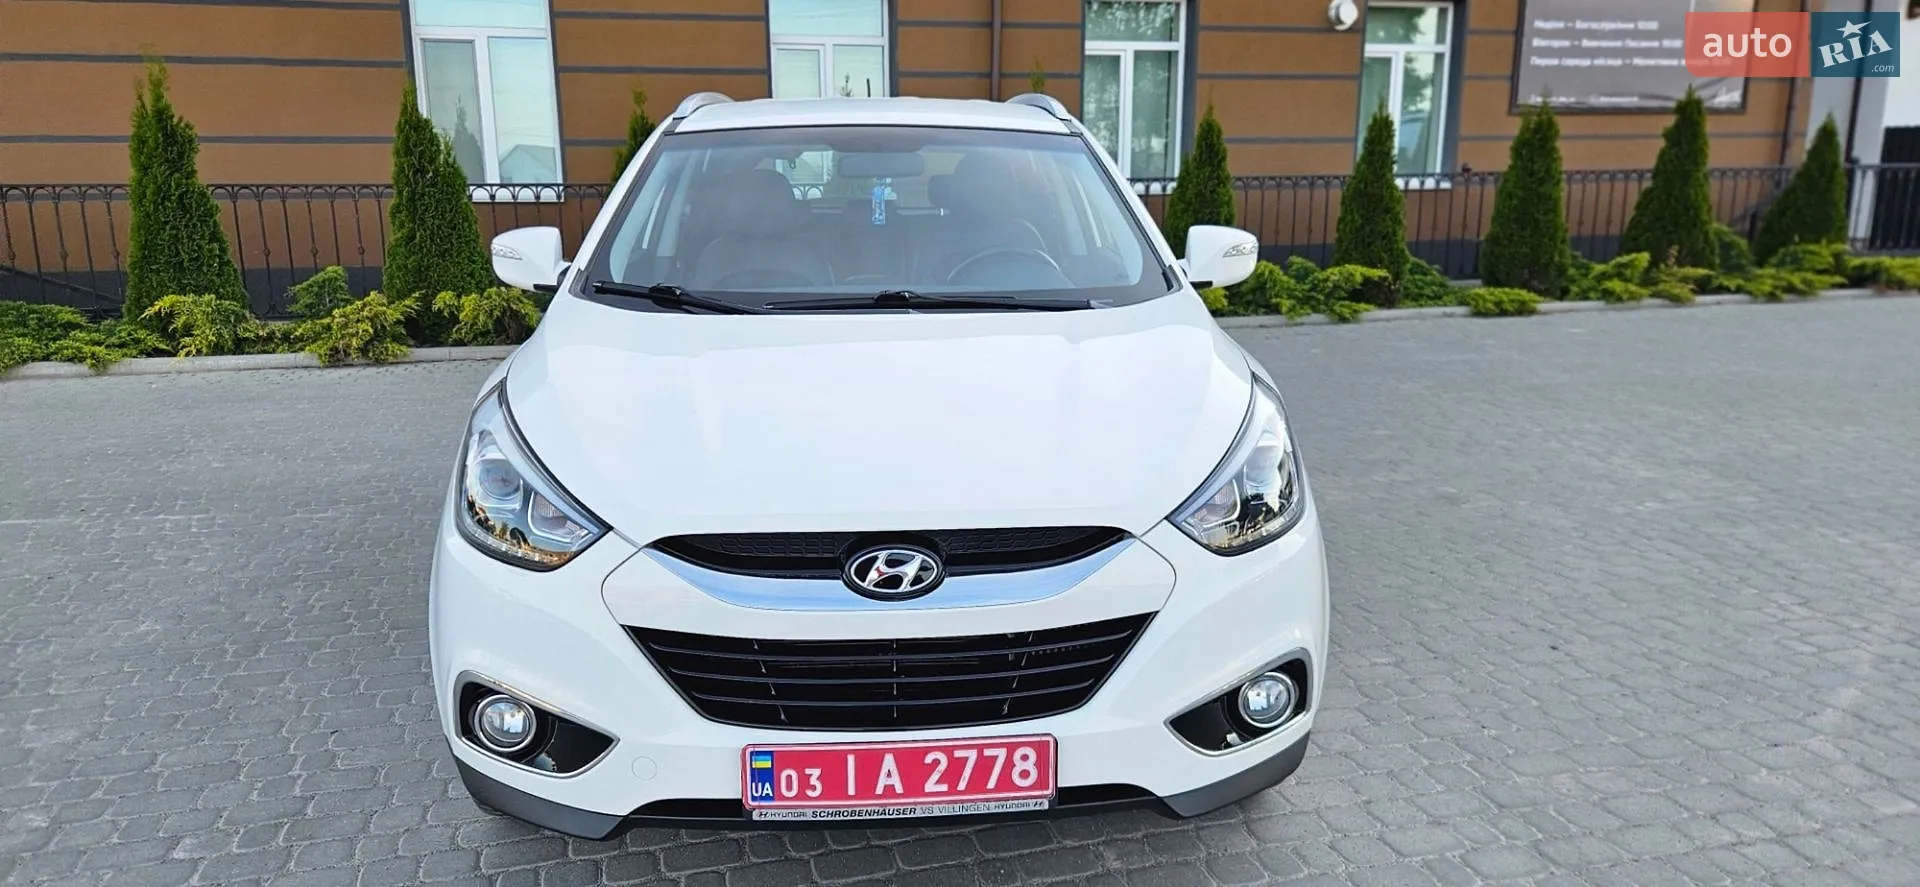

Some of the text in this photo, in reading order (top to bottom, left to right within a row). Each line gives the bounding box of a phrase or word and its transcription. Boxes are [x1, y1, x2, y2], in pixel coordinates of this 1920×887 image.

[780, 768, 822, 798] 03
[924, 747, 1038, 792] 2778
[752, 782, 773, 797] UA
[920, 806, 934, 815] VS
[938, 802, 991, 813] VILLINGEN
